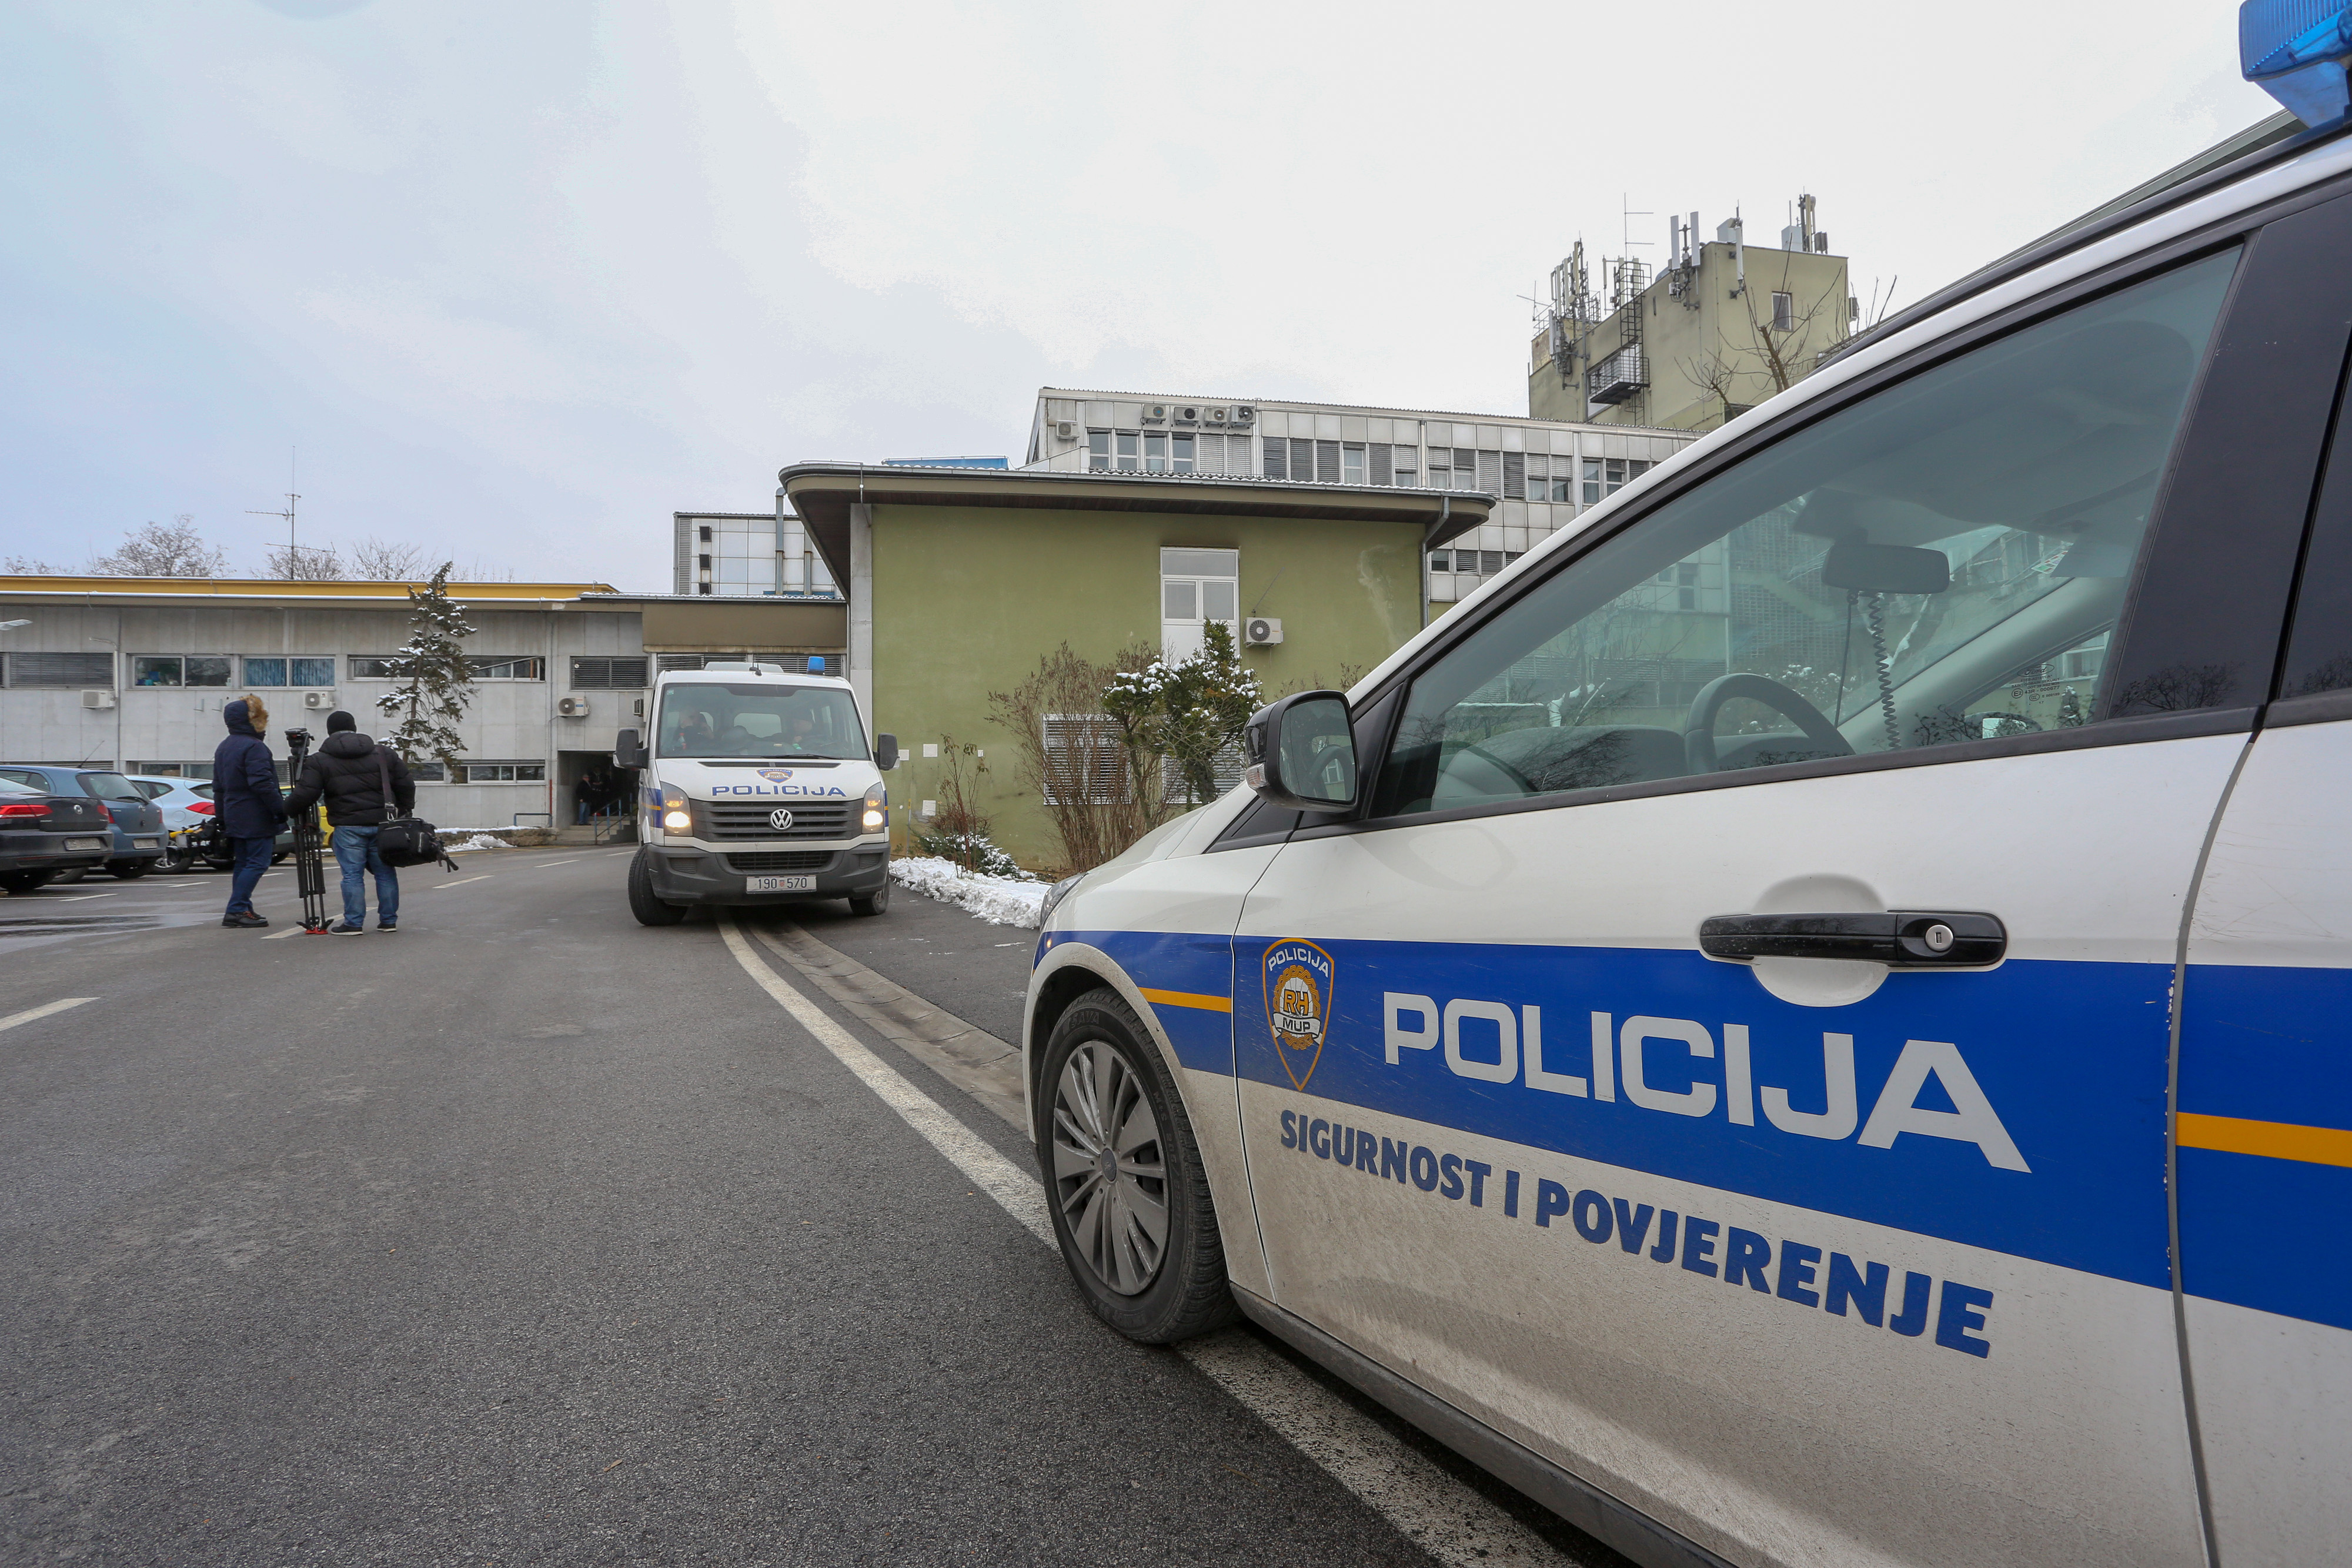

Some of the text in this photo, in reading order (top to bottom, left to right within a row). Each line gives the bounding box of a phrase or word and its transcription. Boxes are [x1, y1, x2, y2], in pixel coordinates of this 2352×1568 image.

[711, 785, 847, 797] POLICIJA
[759, 878, 807, 889] 190 570
[1268, 947, 1328, 978] POLICIJA
[1284, 989, 1309, 1016] RH
[1071, 1011, 1099, 1028] SAVA
[1282, 1017, 1310, 1032] MUP
[1384, 991, 2032, 1174] POLICIJA
[1280, 1109, 1994, 1359] SIGURNOST I POVJERENJE
